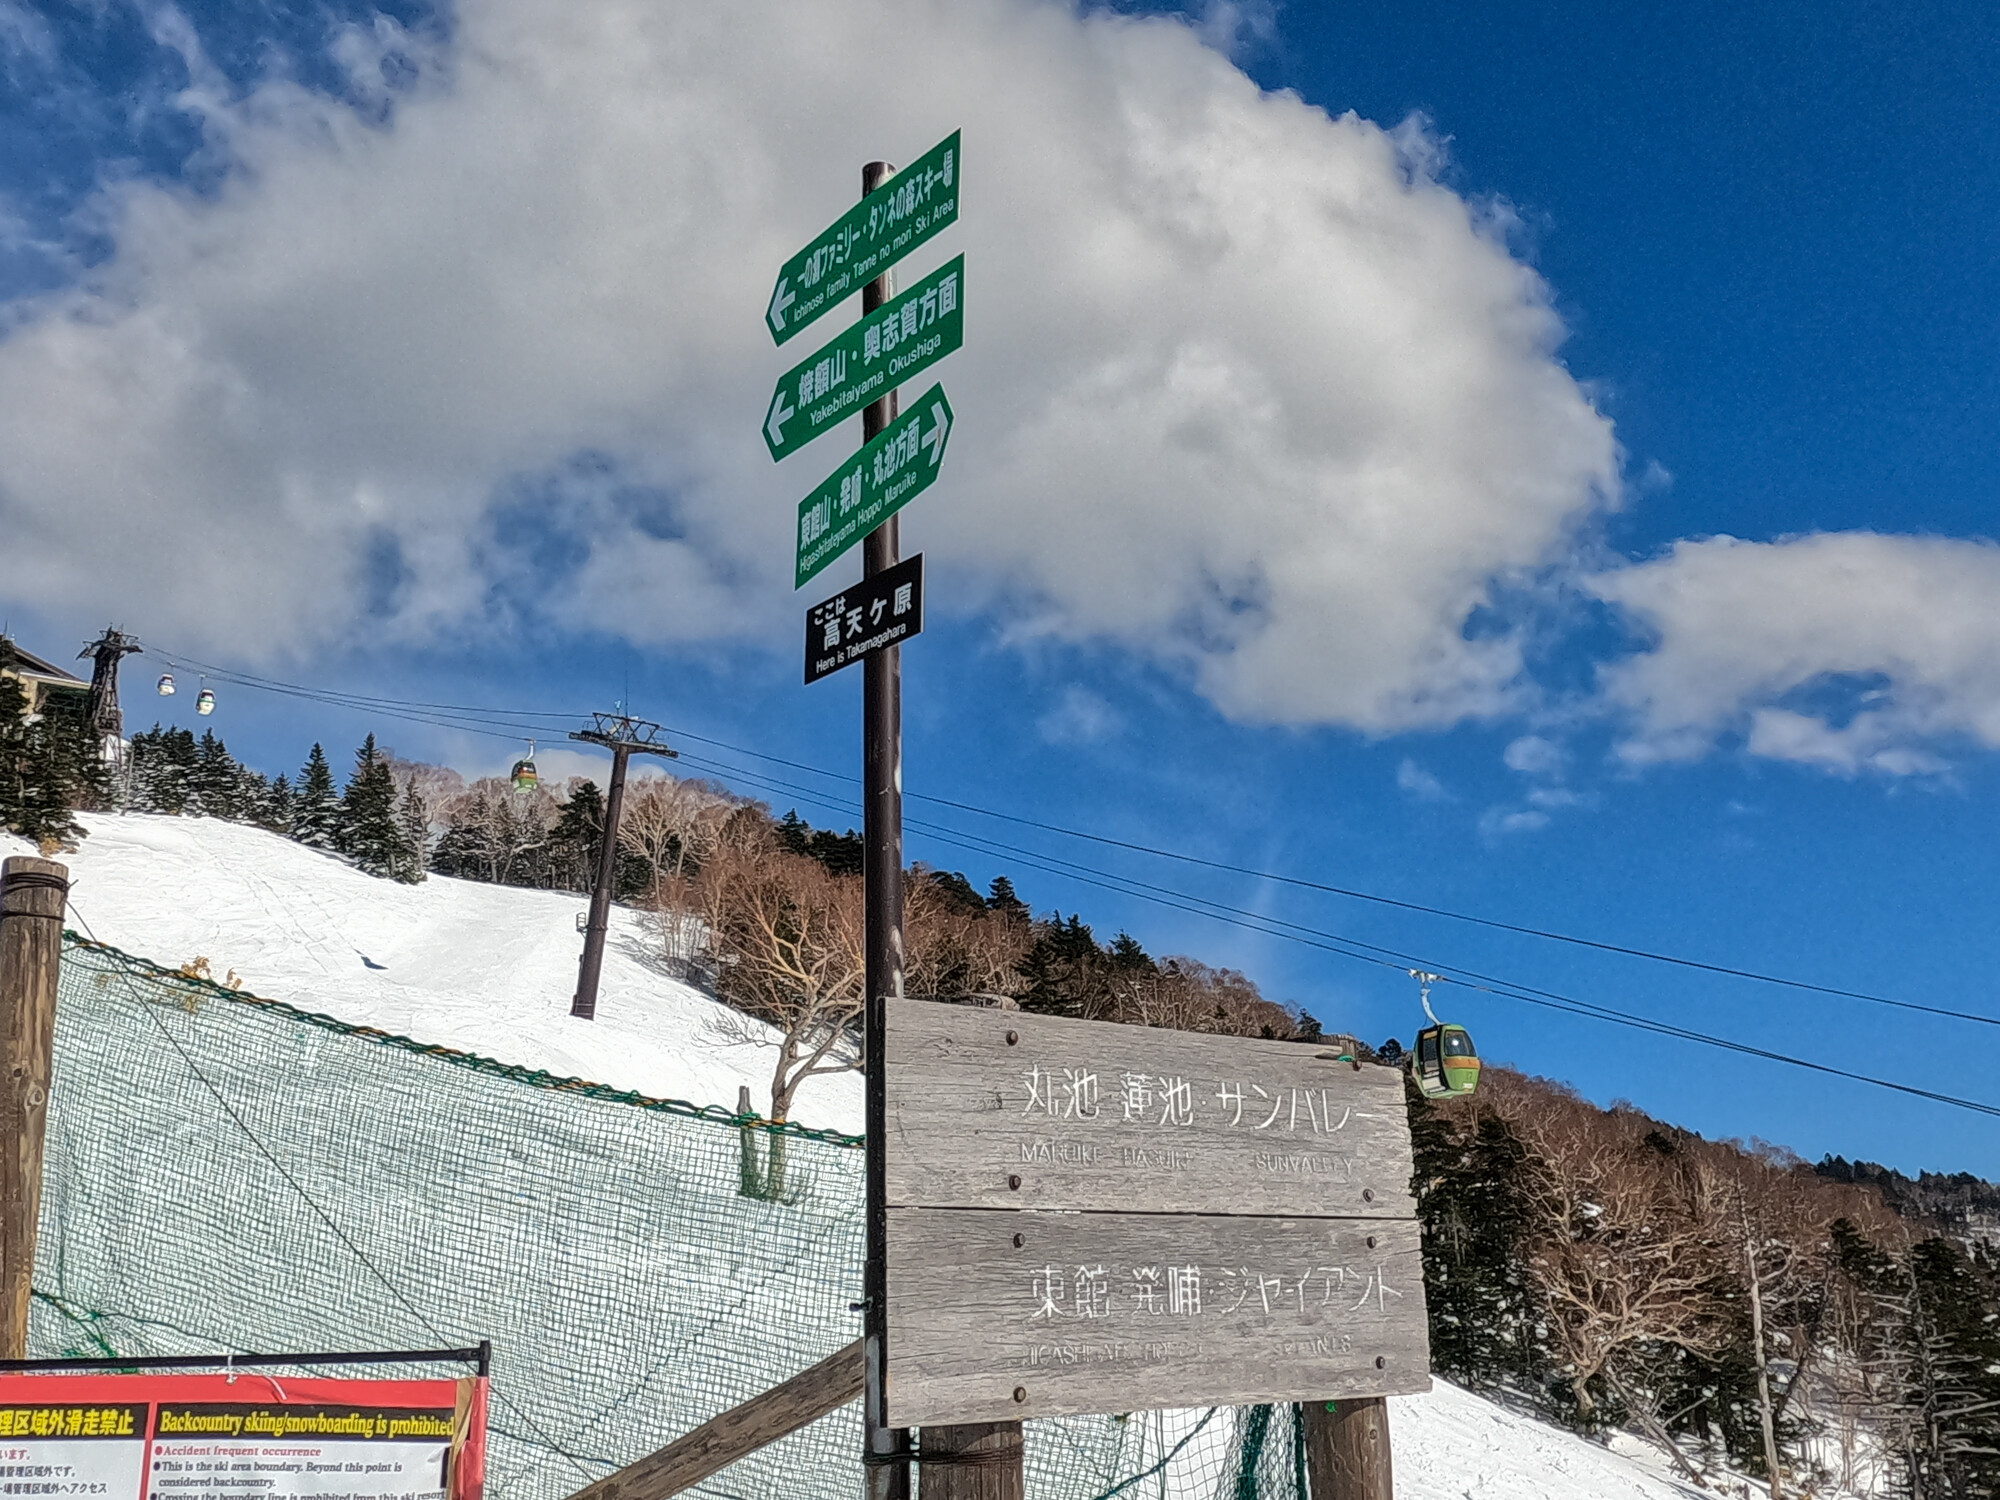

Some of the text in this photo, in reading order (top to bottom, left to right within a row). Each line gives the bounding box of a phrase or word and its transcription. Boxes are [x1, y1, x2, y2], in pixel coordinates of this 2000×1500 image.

[793, 198, 954, 322] Ichinose family Tanne no mori Ski Area
[810, 333, 941, 426] Yakebitaiyama Okushiga
[799, 471, 917, 574] Higashitateyama Hoppo Maruike
[814, 596, 846, 626] ここは
[816, 623, 906, 674] Here is Takamagahara
[1021, 1064, 1101, 1120] 丸池
[1028, 1264, 1110, 1322] 東館
[159, 1410, 455, 1438] Backcountry skiing/snowboarding is prohibited
[161, 1461, 403, 1474] This is the ski area boundary. Beyond this point is
[164, 1446, 322, 1458] Accident frequent occurrence
[159, 1477, 276, 1489] considered backcountry.
